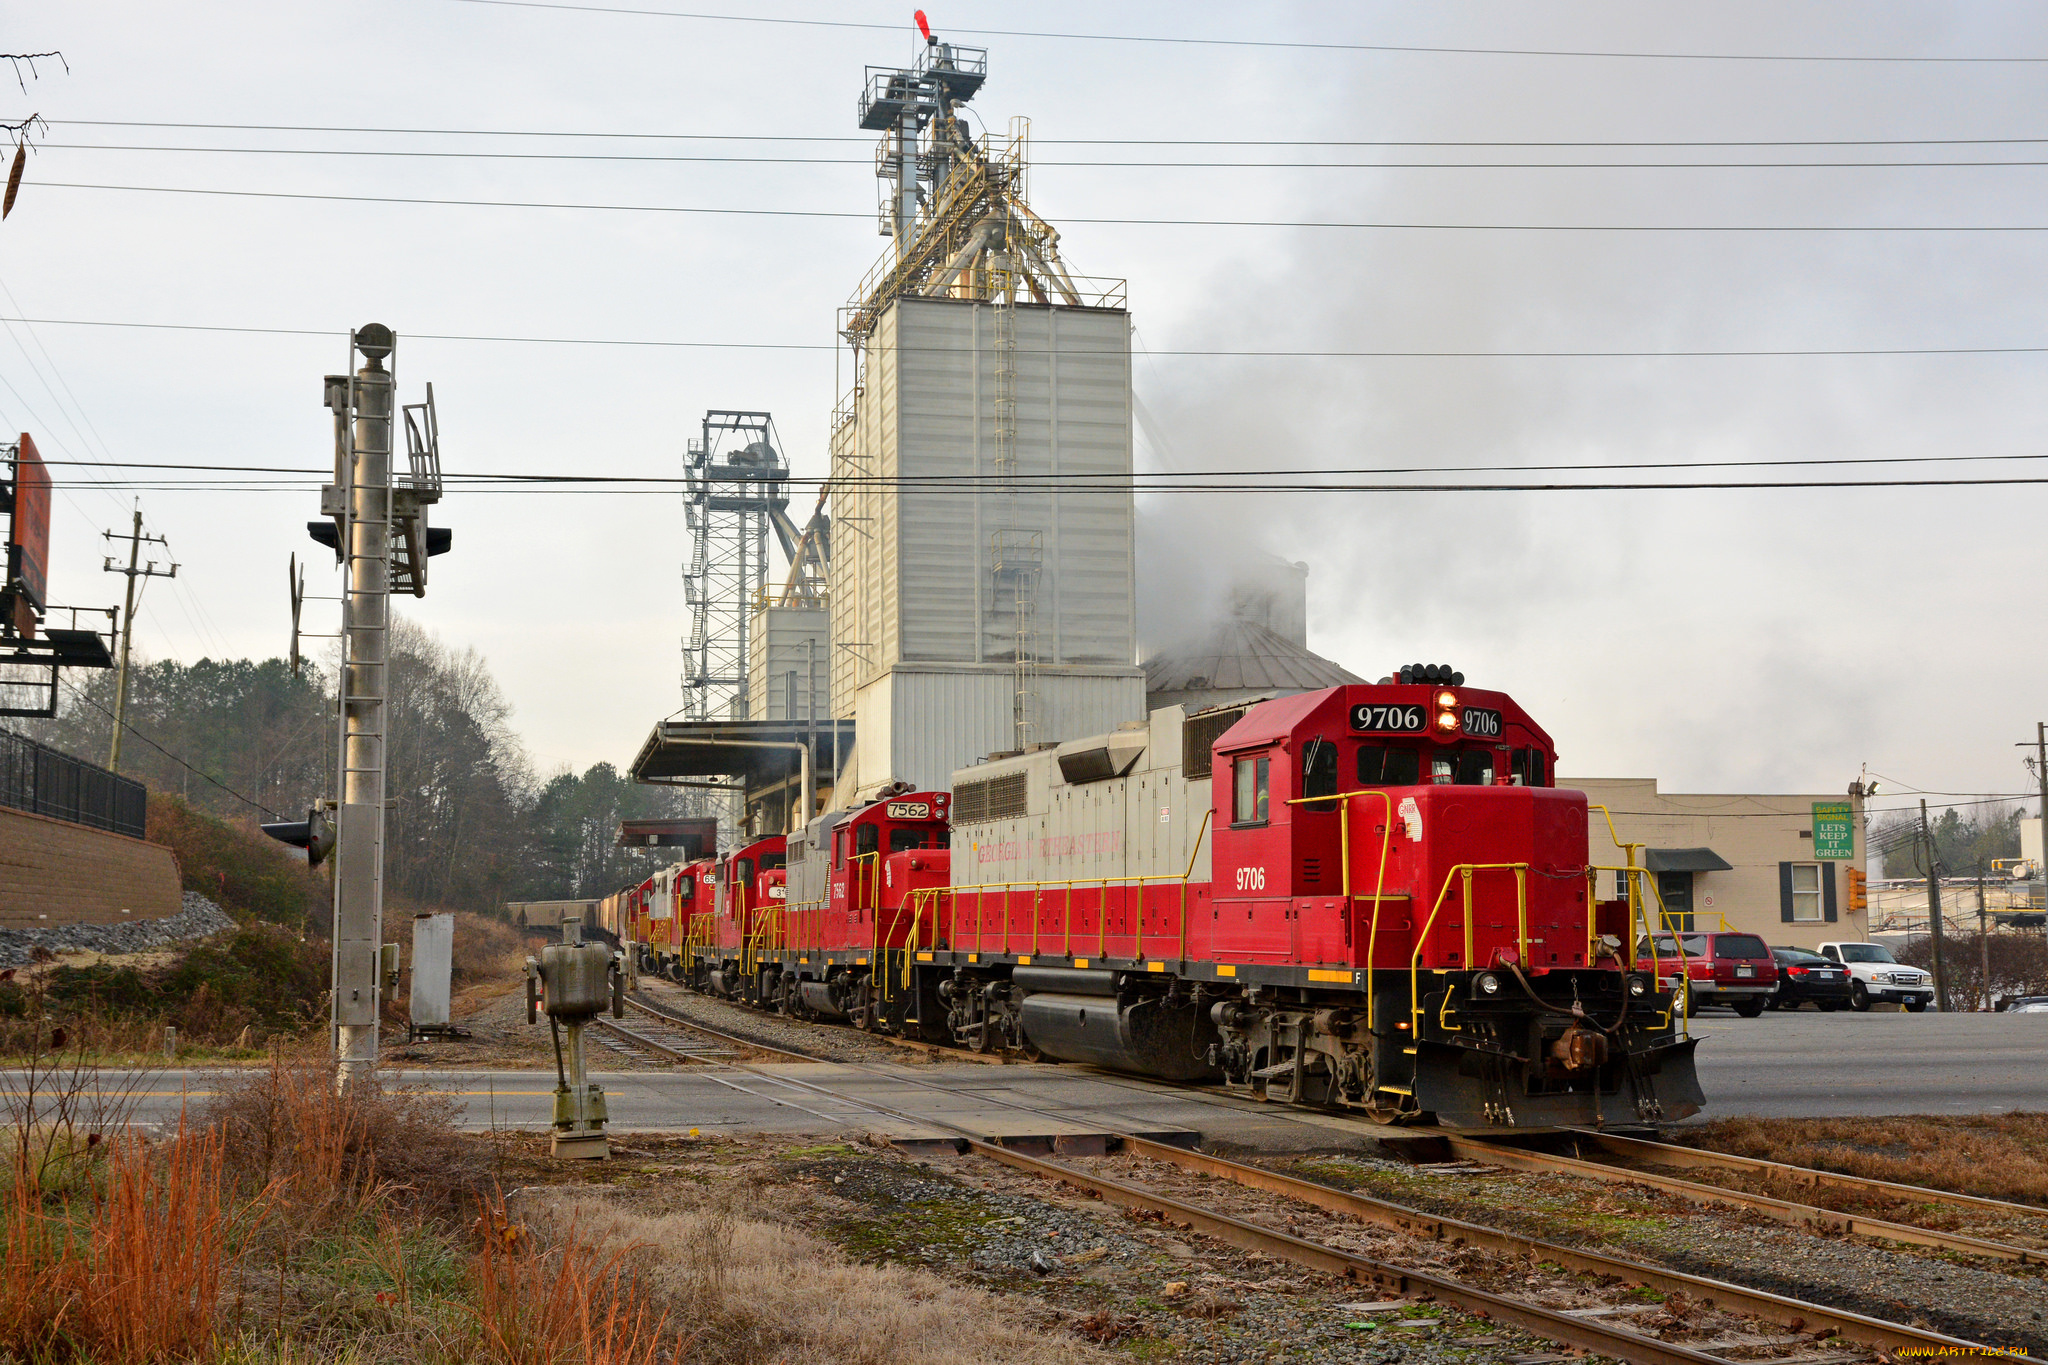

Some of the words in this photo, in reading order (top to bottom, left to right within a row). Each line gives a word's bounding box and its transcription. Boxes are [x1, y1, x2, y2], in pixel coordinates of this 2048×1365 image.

[1358, 707, 1419, 729] 9706
[1465, 710, 1498, 734] 9706
[889, 804, 927, 816] 7562
[978, 840, 1022, 864] GEORGIA
[1024, 830, 1121, 860] NRTHEASTERN
[1816, 849, 1852, 857] GREEN
[1236, 867, 1265, 890] 9706
[833, 882, 845, 899] 7562
[1355, 972, 1361, 984] F
